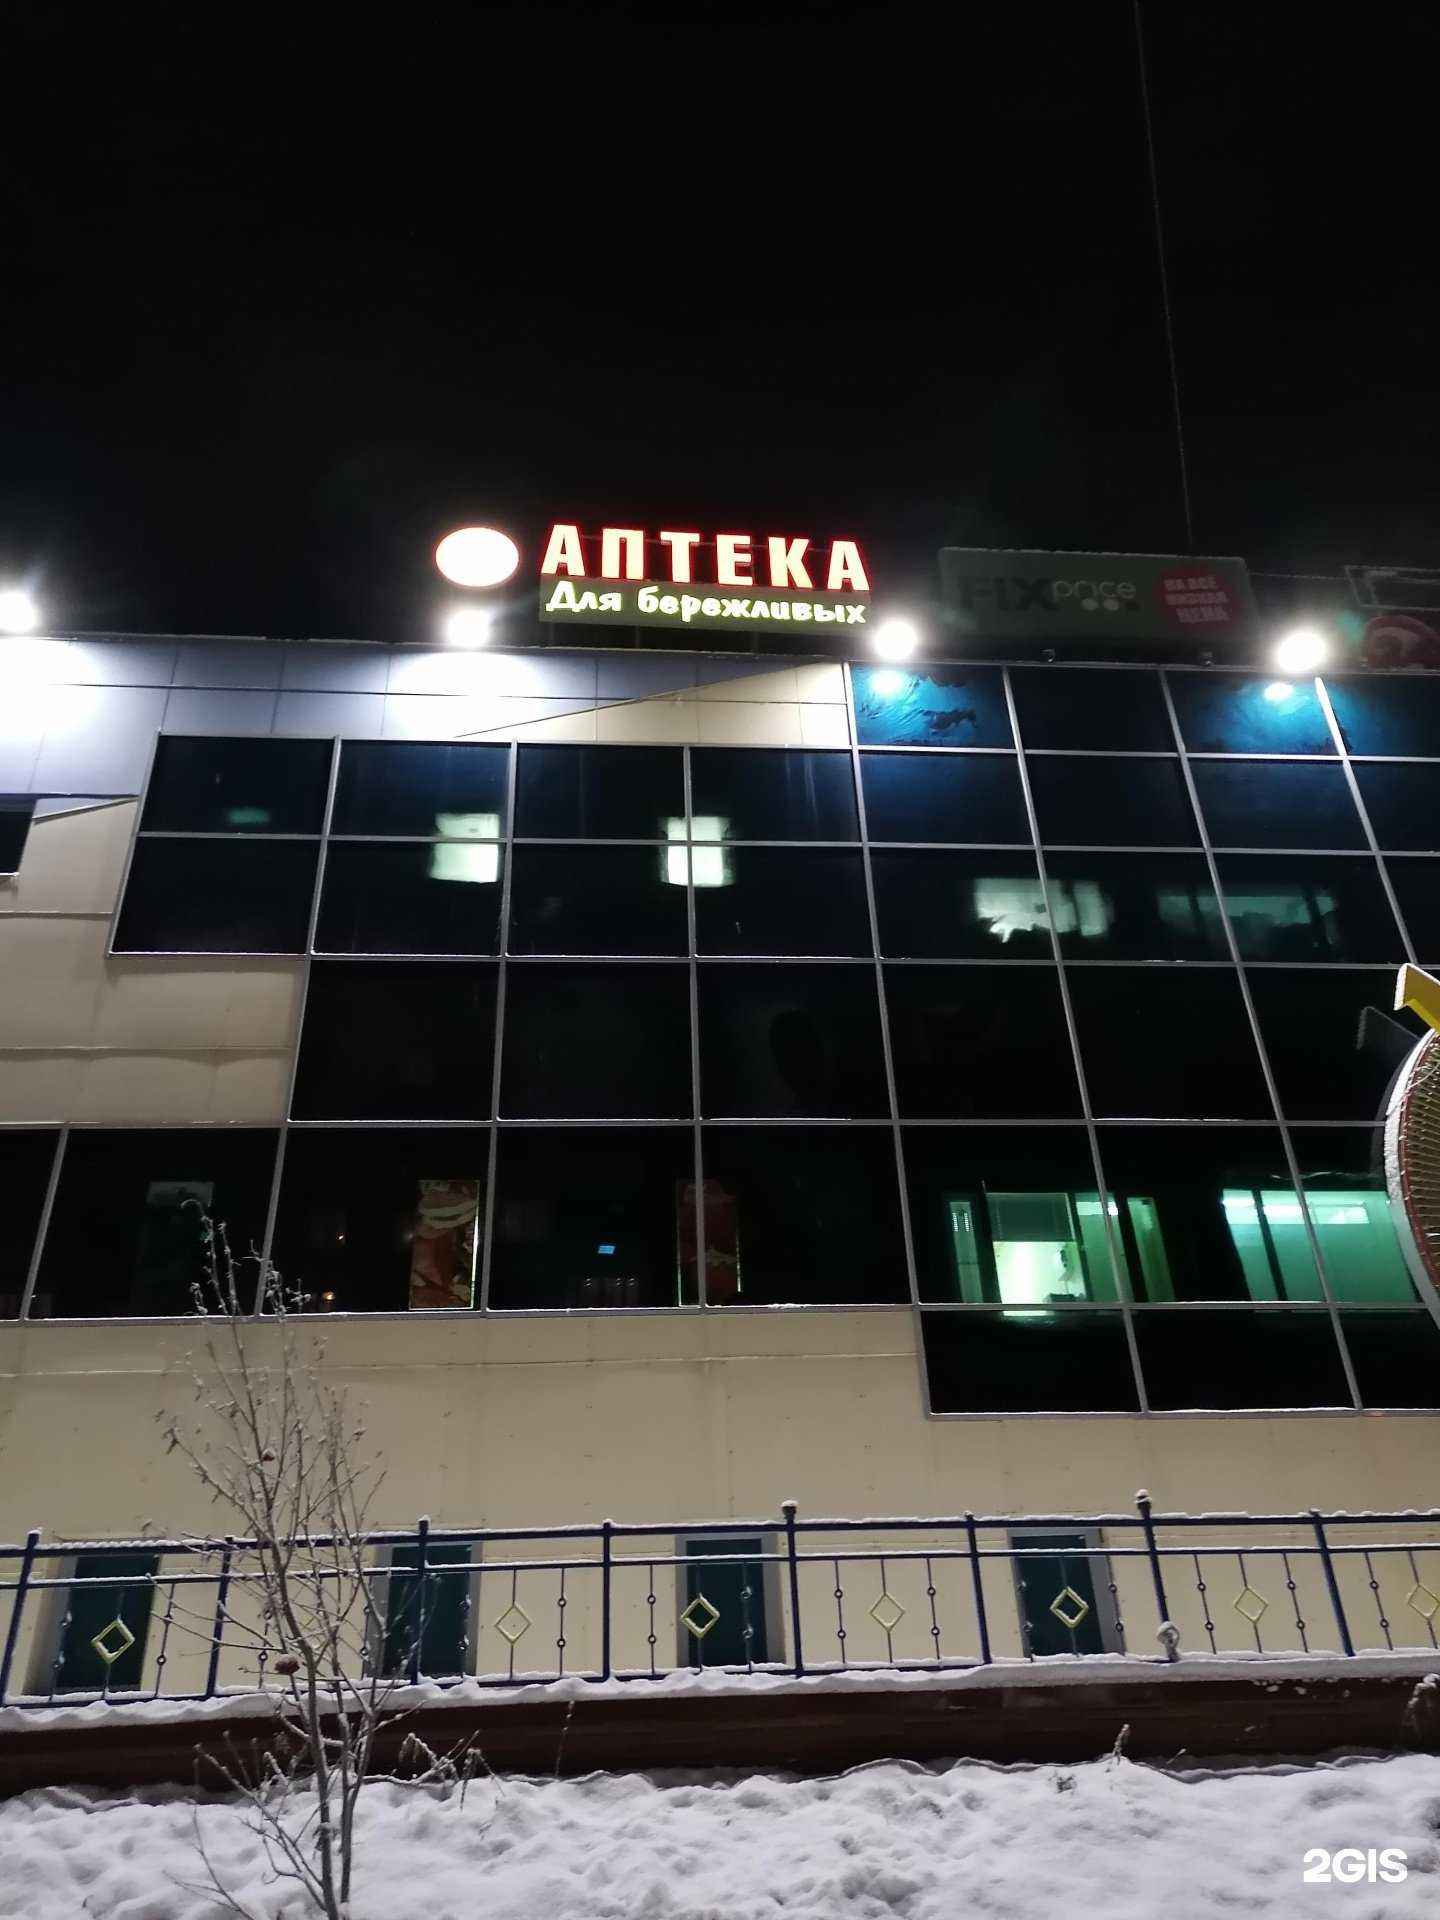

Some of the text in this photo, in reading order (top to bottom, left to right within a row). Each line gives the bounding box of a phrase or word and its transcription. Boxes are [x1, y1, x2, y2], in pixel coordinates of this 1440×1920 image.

[541, 524, 870, 591] АПТЕКА
[546, 580, 866, 623] Для бережливых
